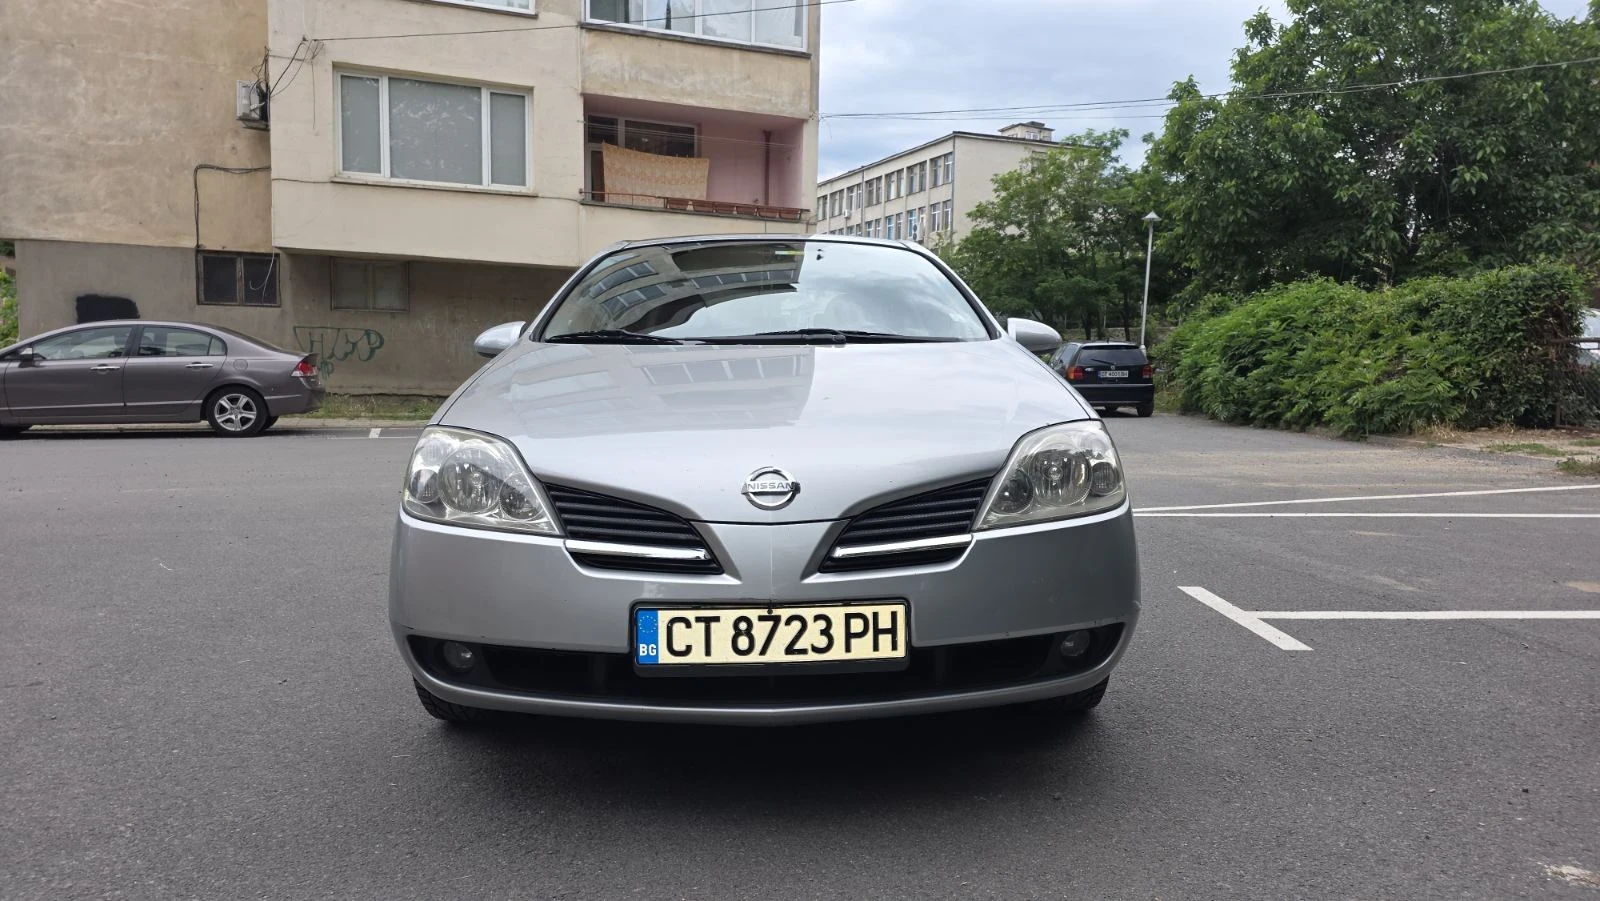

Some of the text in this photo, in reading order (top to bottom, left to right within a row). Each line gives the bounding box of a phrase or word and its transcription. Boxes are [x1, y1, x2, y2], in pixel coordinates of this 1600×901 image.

[747, 482, 795, 490] NISSAN
[666, 611, 898, 657] CT 8723 PH
[639, 644, 657, 656] BG
